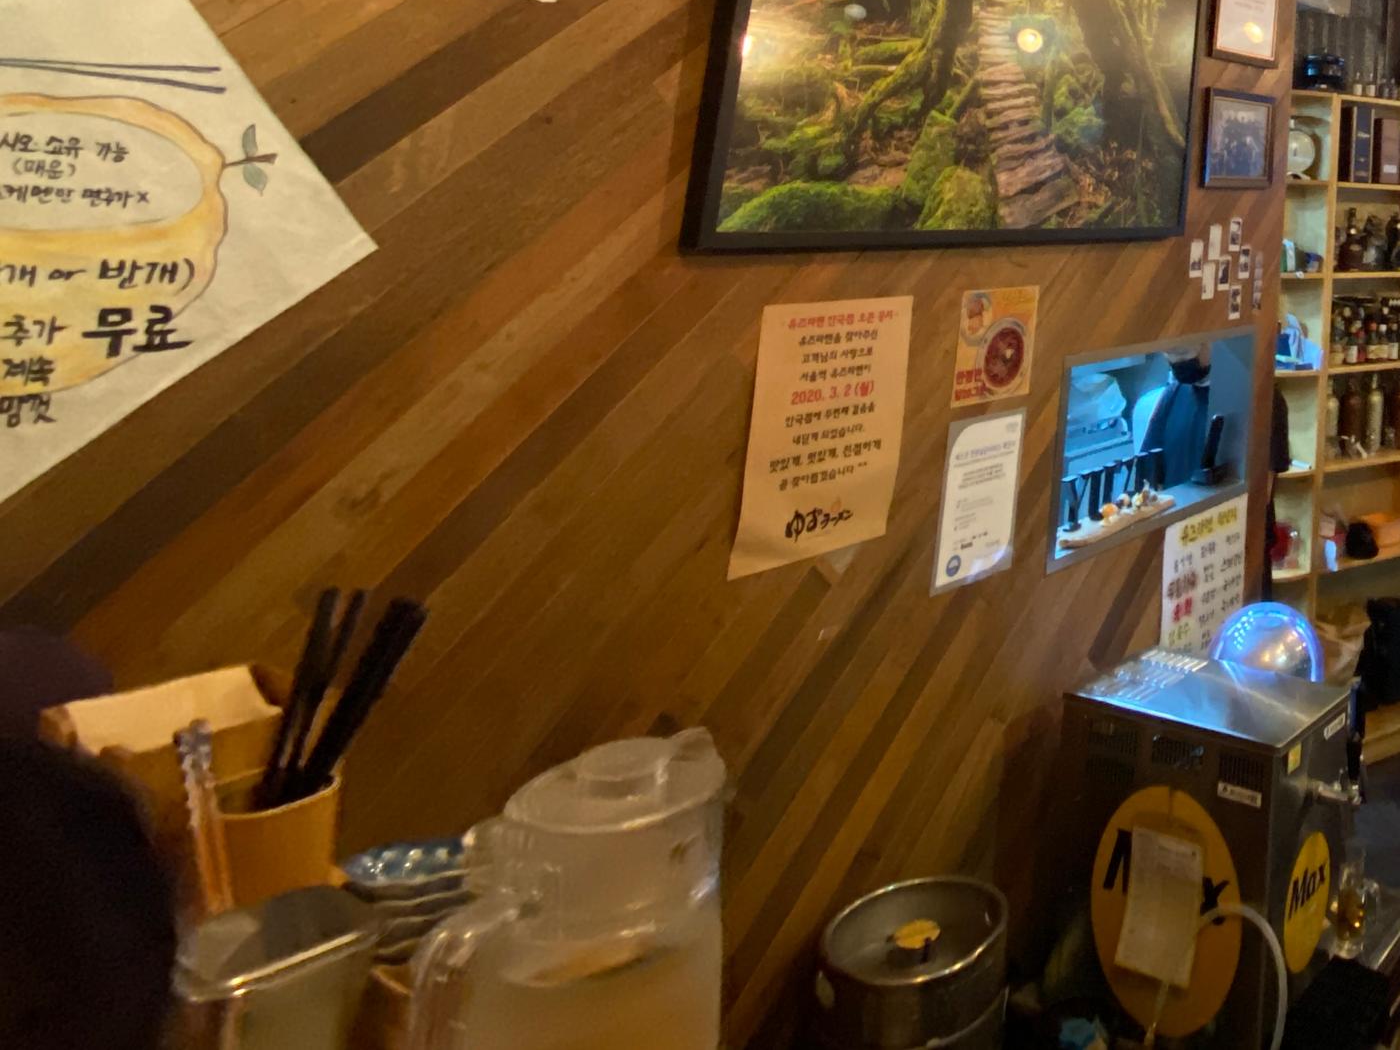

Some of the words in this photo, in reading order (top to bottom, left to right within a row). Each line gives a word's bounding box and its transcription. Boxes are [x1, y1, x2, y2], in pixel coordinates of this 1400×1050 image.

[95, 140, 129, 163] 가능
[0, 184, 75, 204] 케멘만
[48, 269, 87, 281] or
[82, 305, 194, 358] 무료
[1289, 862, 1328, 920] Max
